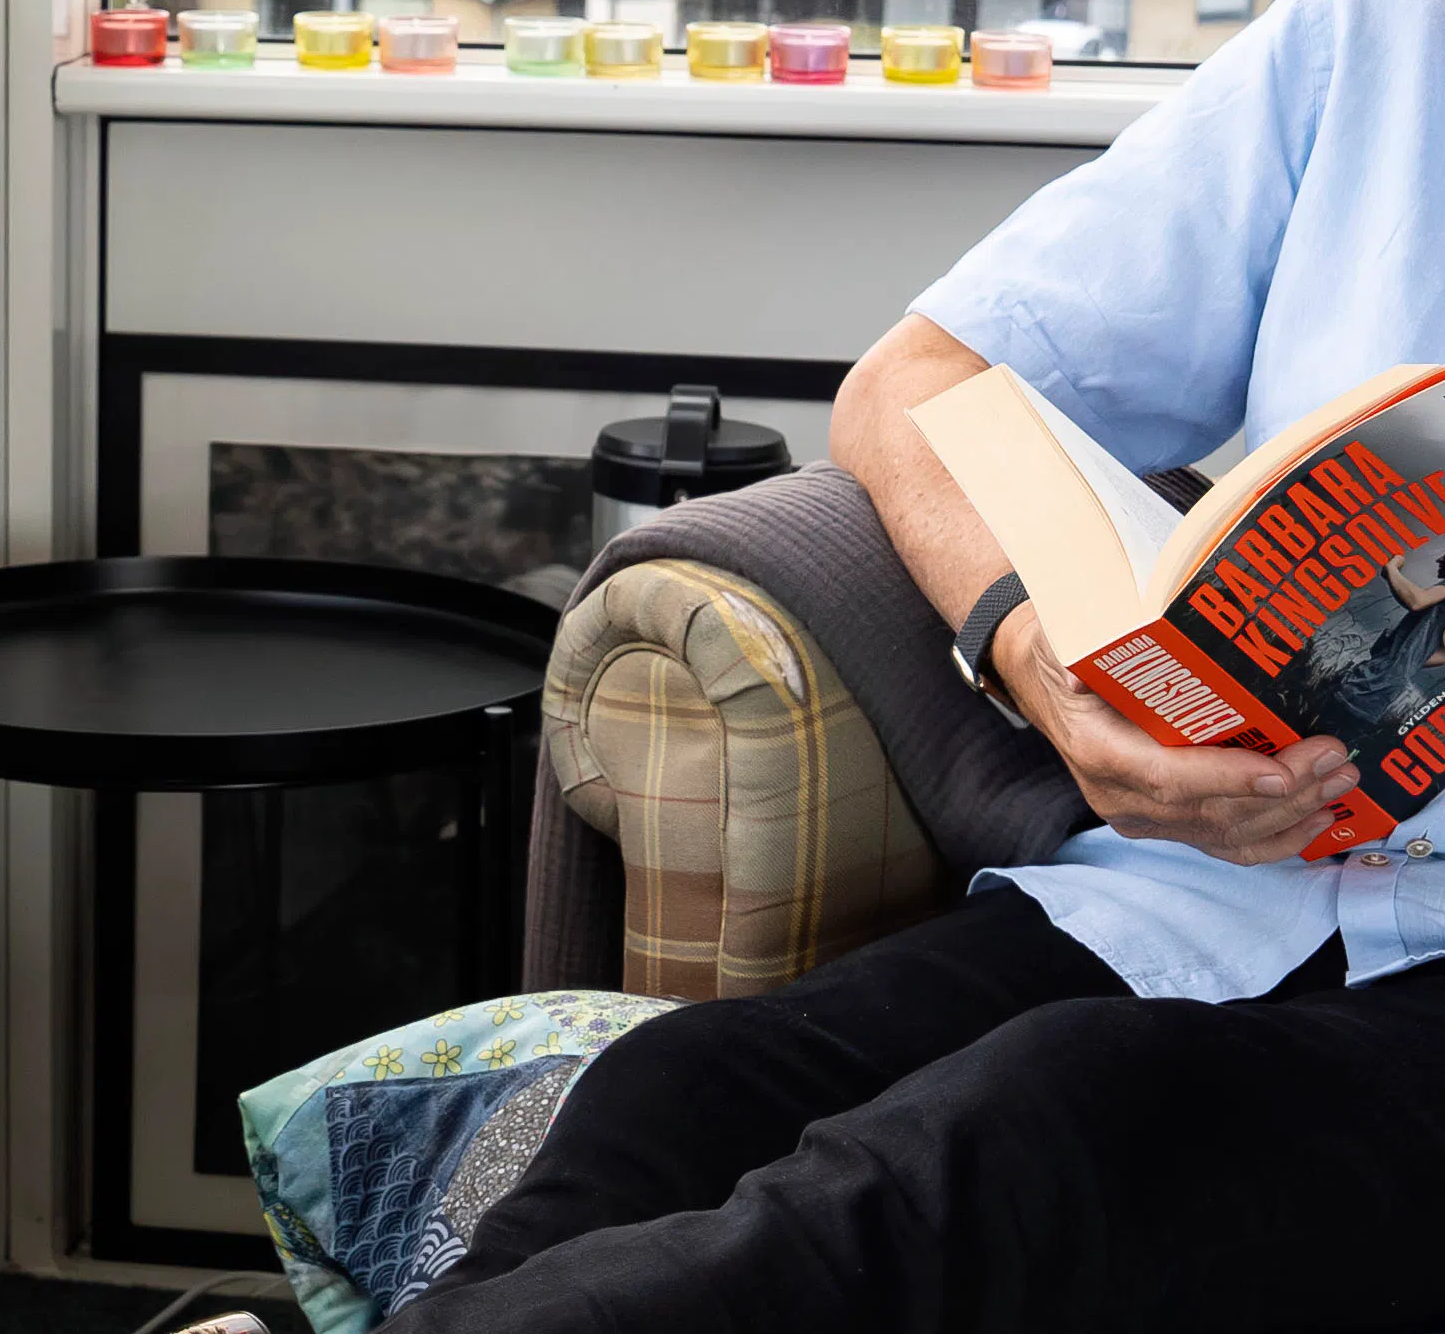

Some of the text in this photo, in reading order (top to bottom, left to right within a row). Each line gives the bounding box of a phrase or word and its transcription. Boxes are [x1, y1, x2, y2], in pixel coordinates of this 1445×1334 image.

[1188, 440, 1407, 639] BARBARA
[1093, 634, 1157, 671] BARBARA
[1106, 644, 1246, 744] KINGSOLVER
